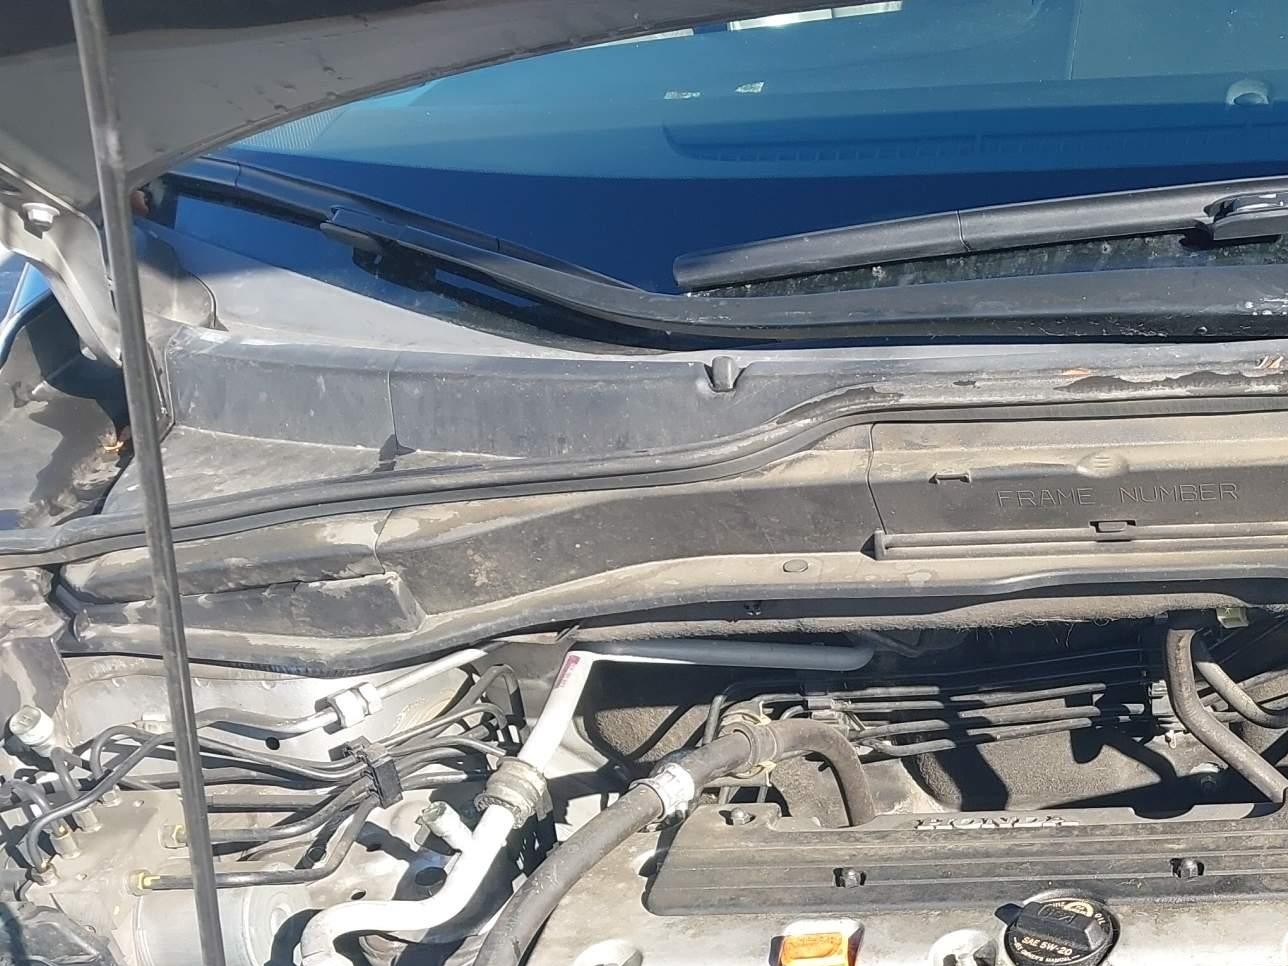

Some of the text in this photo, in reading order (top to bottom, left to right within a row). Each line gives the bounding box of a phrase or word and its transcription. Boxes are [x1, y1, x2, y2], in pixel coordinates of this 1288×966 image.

[995, 482, 1240, 507] FRAME NUMBER
[1021, 936, 1073, 957] SAE 5W-20
